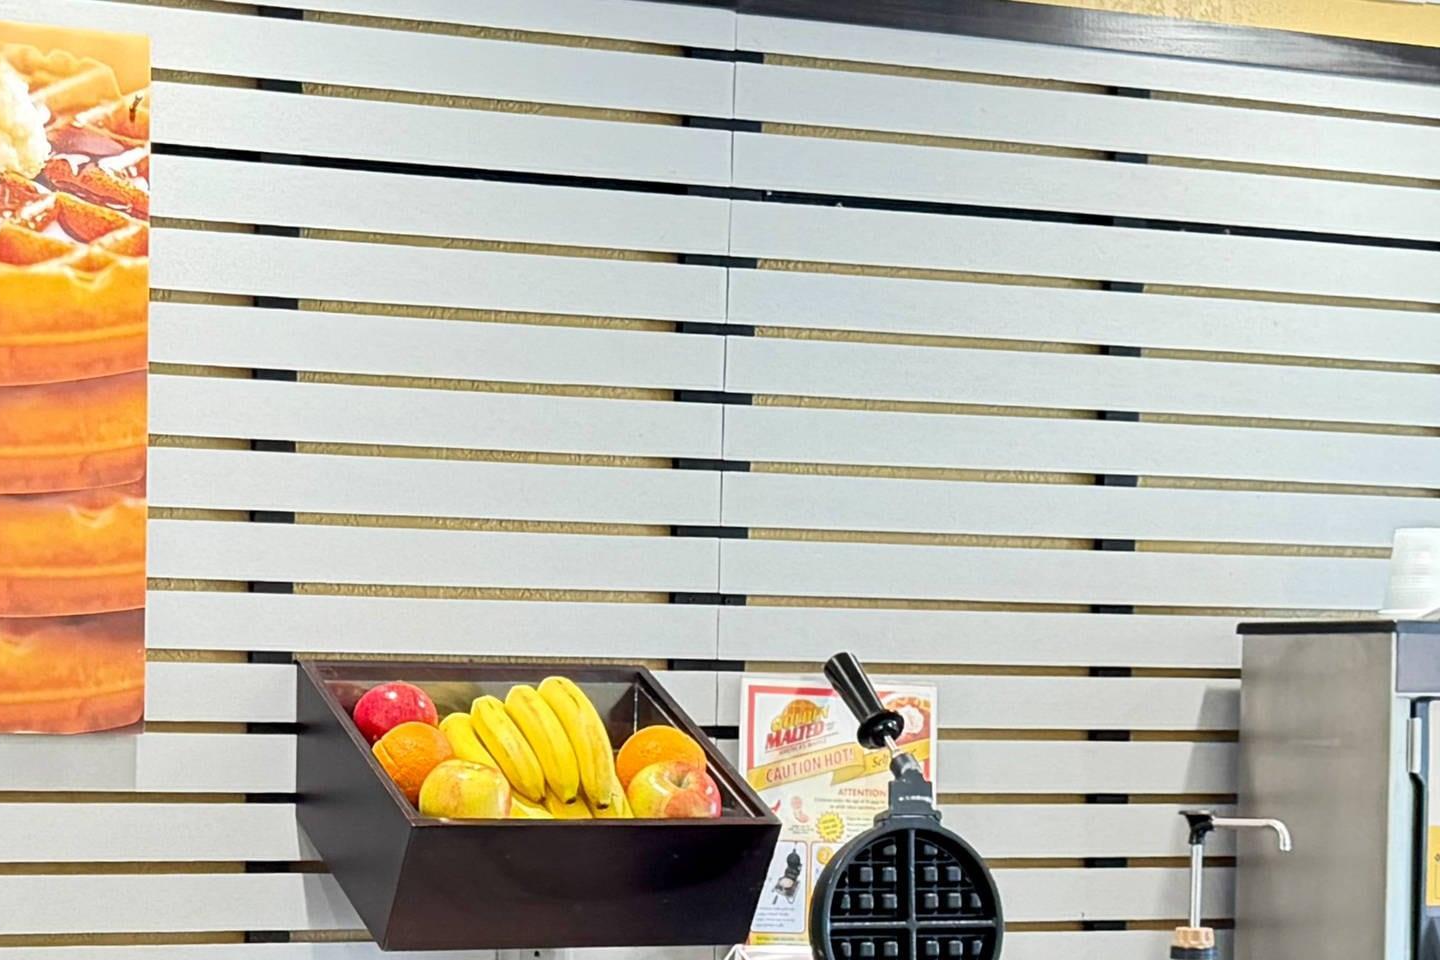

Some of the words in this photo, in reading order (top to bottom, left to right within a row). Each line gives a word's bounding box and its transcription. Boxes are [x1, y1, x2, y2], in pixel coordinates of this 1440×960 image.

[766, 721, 824, 749] MALTED
[766, 756, 820, 783] CAUTION
[825, 748, 854, 767] HOT!
